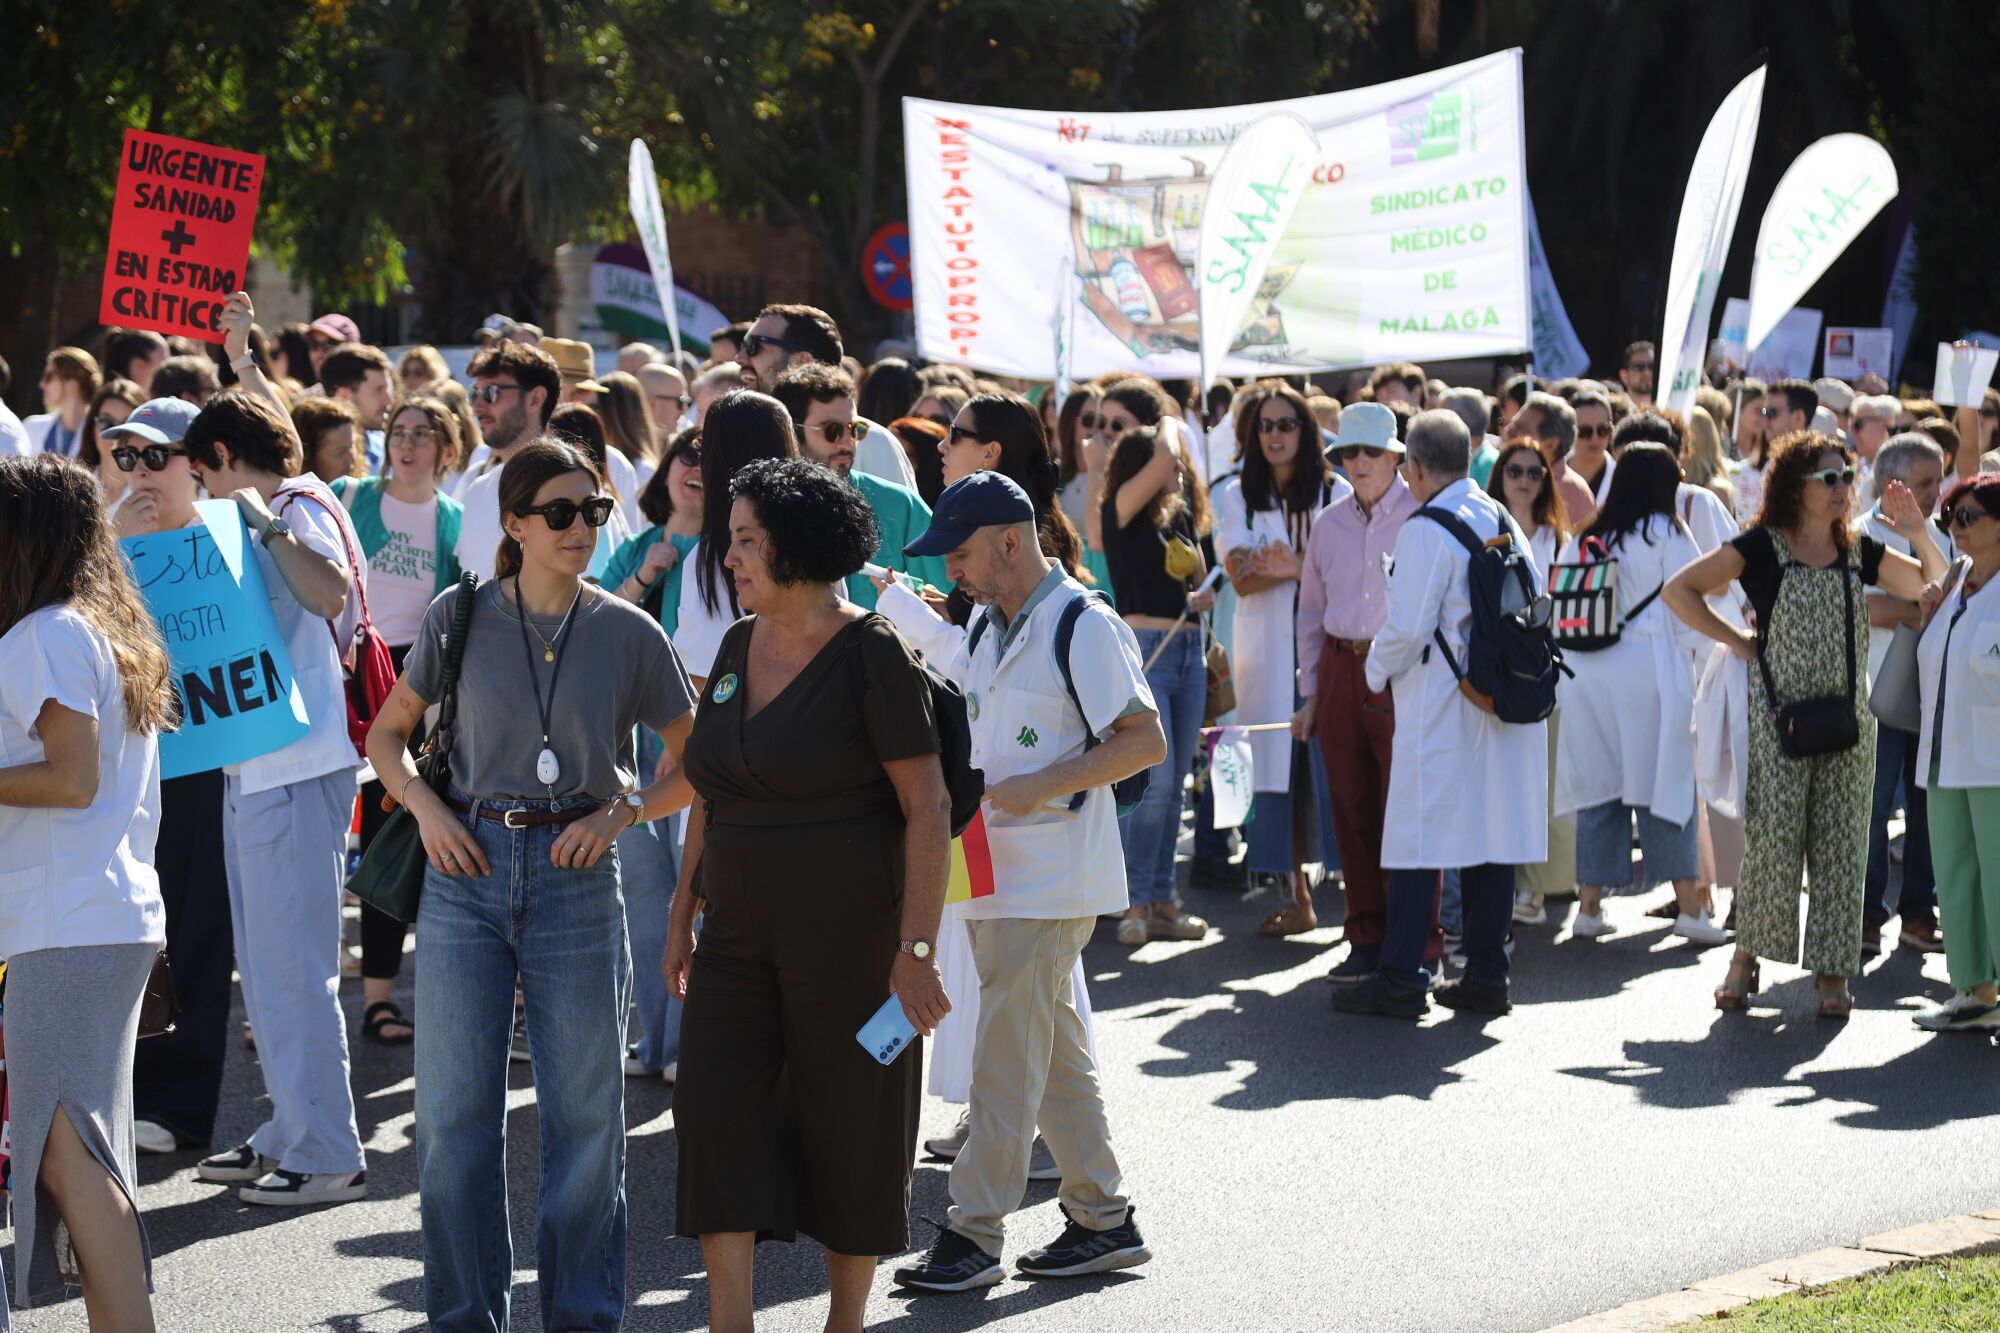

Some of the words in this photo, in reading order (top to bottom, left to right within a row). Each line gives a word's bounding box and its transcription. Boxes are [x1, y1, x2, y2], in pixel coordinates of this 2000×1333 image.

[133, 183, 236, 224] SANIDAD
[1370, 177, 1506, 215] SINDICATO
[1390, 223, 1487, 255] MÉDICO
[115, 250, 148, 280] EN
[157, 257, 236, 295] ESTADO
[1424, 271, 1457, 292] DE
[112, 286, 224, 332] CRÍTICO
[1379, 306, 1500, 335] MÁLAGA
[387, 541, 435, 560] OURITE
[390, 530, 412, 544] MY
[375, 549, 417, 568] OLOR
